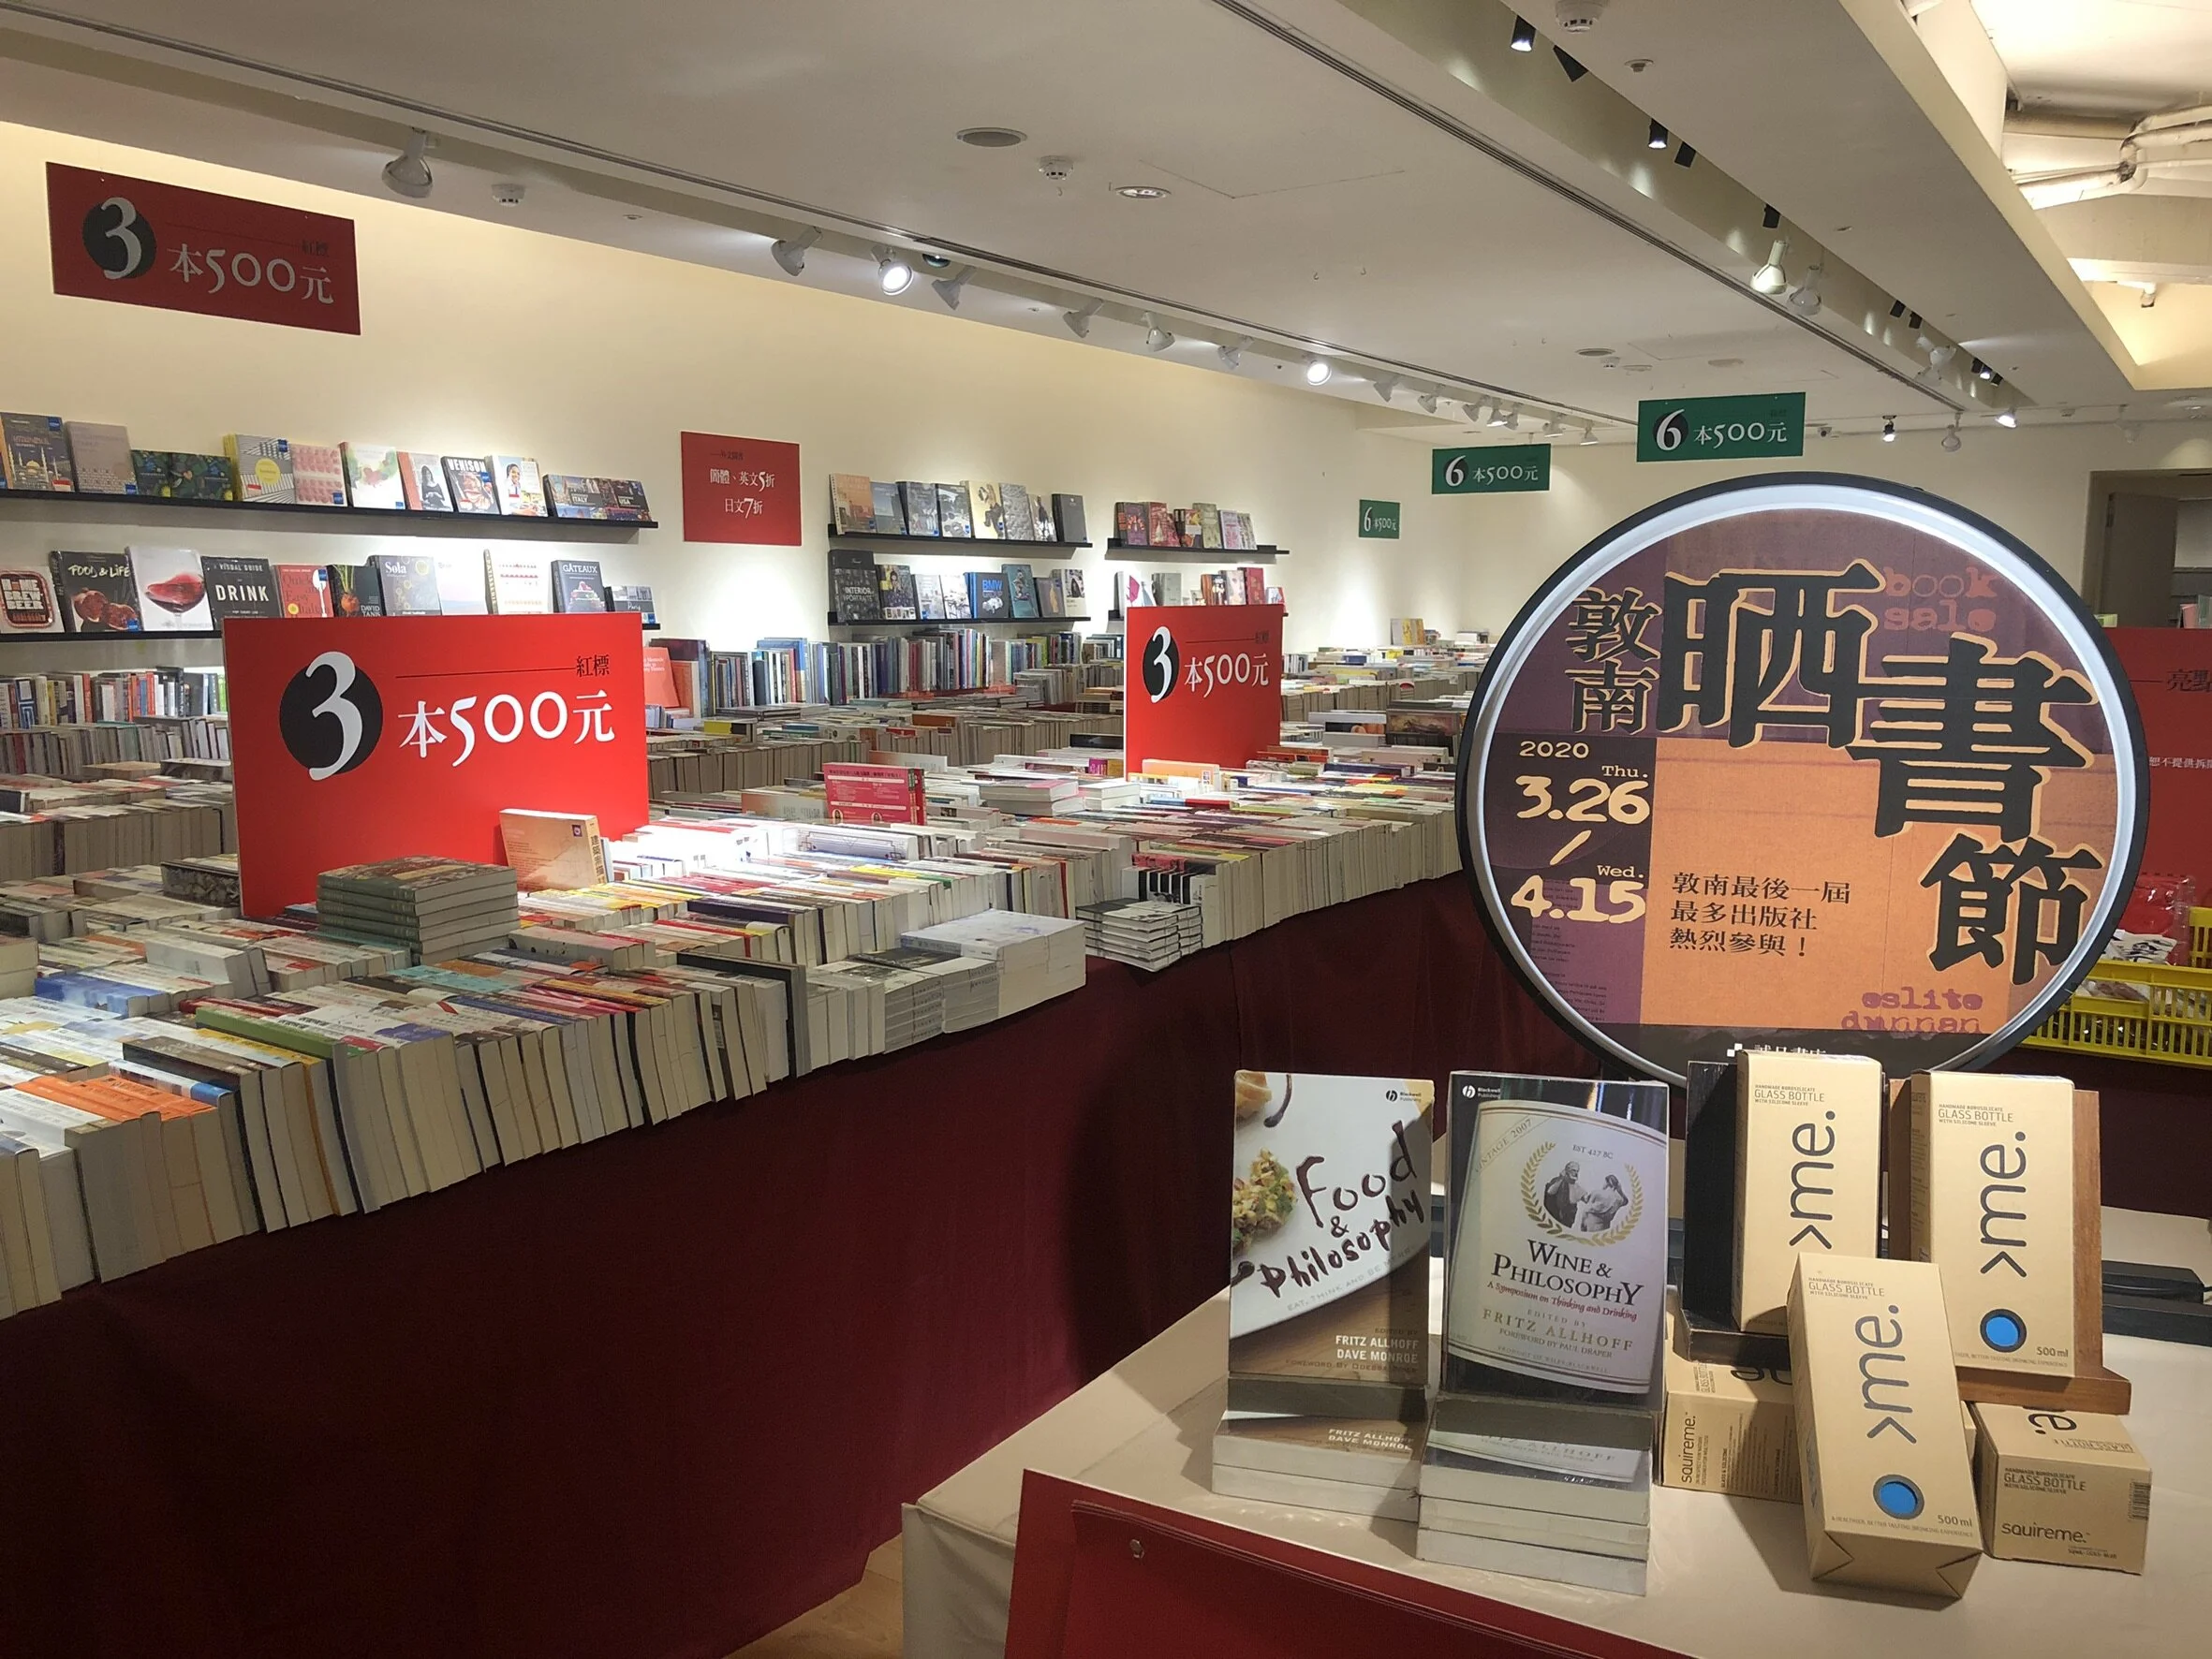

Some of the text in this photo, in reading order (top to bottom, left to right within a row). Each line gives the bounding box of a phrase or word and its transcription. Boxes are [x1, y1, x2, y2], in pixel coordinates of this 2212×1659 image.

[447, 458, 486, 473] VENISON
[571, 494, 588, 503] ITALY
[725, 497, 763, 519] 日文7折
[385, 562, 407, 574] Sola
[982, 579, 1003, 591] BMW
[1883, 566, 2000, 598] book
[214, 584, 270, 602] DRINK
[1883, 599, 1997, 632] sale
[576, 653, 611, 678] 紅標
[1564, 586, 1661, 735] 敦南
[1519, 741, 1589, 758] 2020
[1601, 765, 1649, 778] Thu.
[1515, 775, 1650, 825] 3.26
[1597, 864, 1644, 878] Wed.
[1672, 872, 1851, 904] 敦南最後一屆
[1511, 874, 1646, 924] 4.15
[1670, 900, 1818, 931] 最多出版社
[1862, 987, 1983, 1011] eslite
[1841, 1010, 1983, 1037] dunnan
[1754, 1089, 1825, 1102] GLASS BOTTLE
[1938, 1108, 2014, 1123] GLASS BOTTLE
[1511, 1118, 1533, 1139] 2007
[1572, 1144, 1586, 1154] EST
[1602, 1150, 1614, 1160] BC
[1296, 1120, 1417, 1228] Food
[1330, 1215, 1349, 1238] &
[1596, 1262, 1614, 1279] &
[1808, 1282, 1885, 1297] GLASS BOTTLE
[1495, 1283, 1539, 1302] Symposium
[1551, 1297, 1585, 1314] Thinking
[1586, 1305, 1601, 1314] and
[1602, 1307, 1637, 1323] Drinking
[1527, 1309, 1569, 1325] EDITED
[1482, 1309, 1633, 1352] FRITZ ALLHOFF
[1335, 1335, 1420, 1350] FRITZ ALLHOFF
[1499, 1328, 1613, 1358] FOREWORD BY PAUL DRAPER
[1336, 1348, 1419, 1364] DAVE MONROE
[1328, 1429, 1361, 1438] FRITZ
[1328, 1435, 1360, 1445] DAVE
[2004, 1472, 2087, 1491] GLASS BOTTLE
